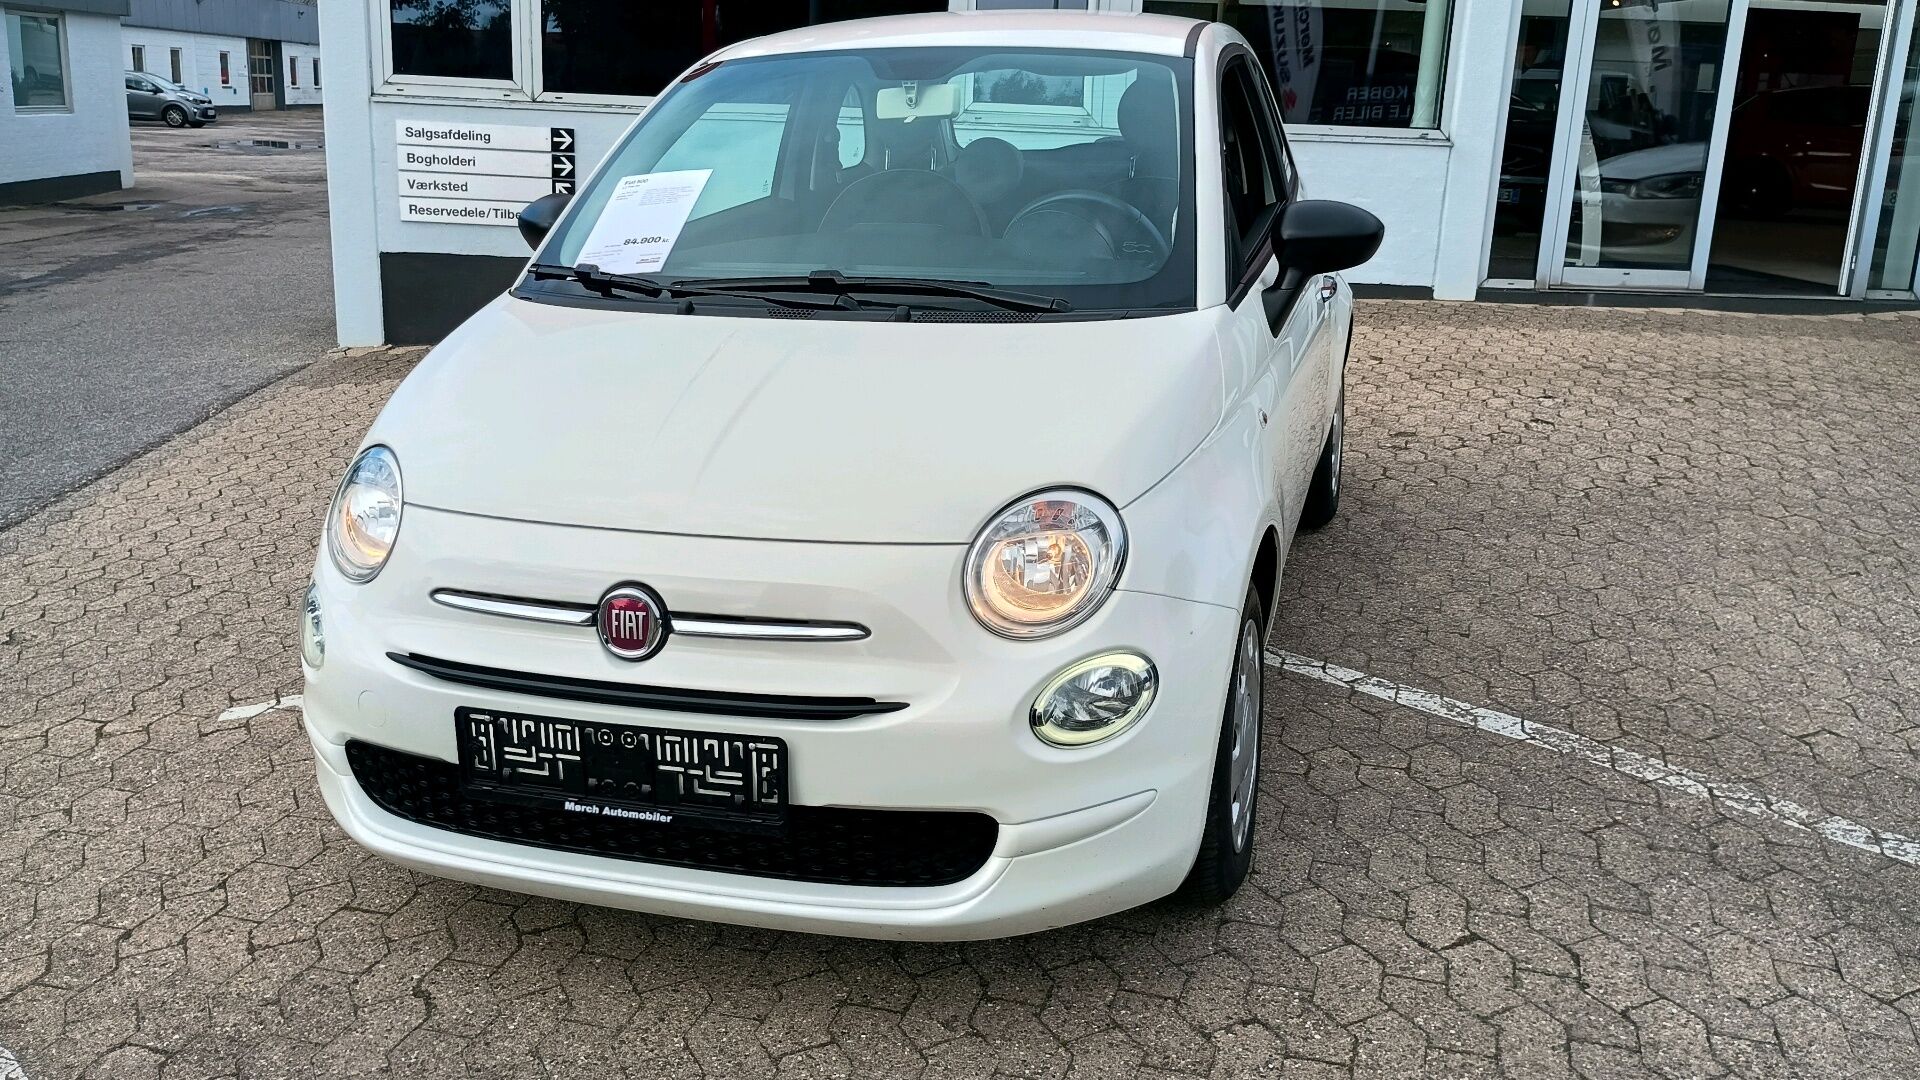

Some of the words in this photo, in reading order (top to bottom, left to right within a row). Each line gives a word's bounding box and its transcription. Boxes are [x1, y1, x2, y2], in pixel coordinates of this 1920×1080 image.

[405, 127, 491, 143] Salgsafdeling
[407, 153, 476, 167] Bogholderi
[407, 179, 468, 192] Værksted
[623, 236, 662, 246] 84.900
[611, 609, 647, 640] FIAT
[564, 801, 599, 814] Mørch
[602, 806, 673, 823] Automobiler
